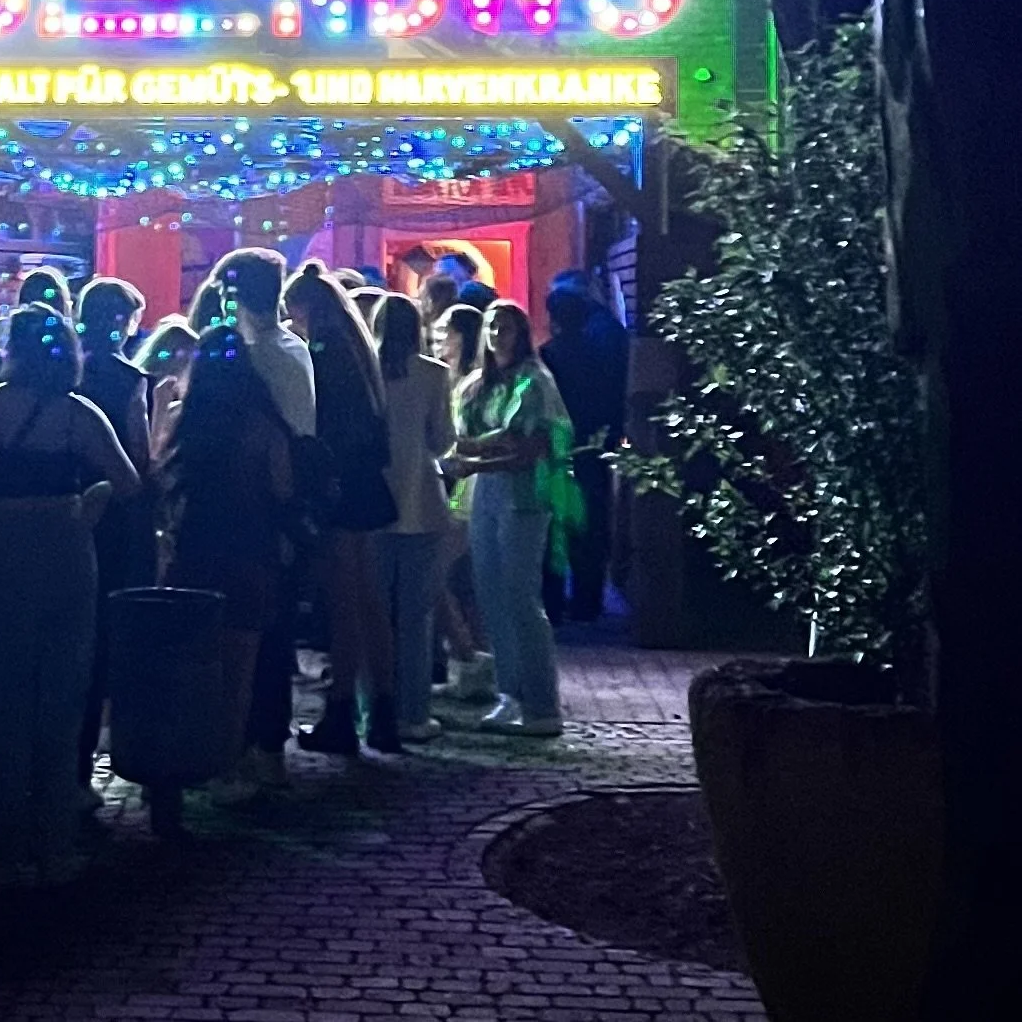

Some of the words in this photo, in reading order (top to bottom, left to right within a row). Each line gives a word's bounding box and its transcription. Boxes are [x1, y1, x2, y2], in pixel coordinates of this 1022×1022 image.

[52, 63, 127, 104] FÜR
[130, 63, 289, 104] GEMÜTS-
[291, 69, 372, 104] UND
